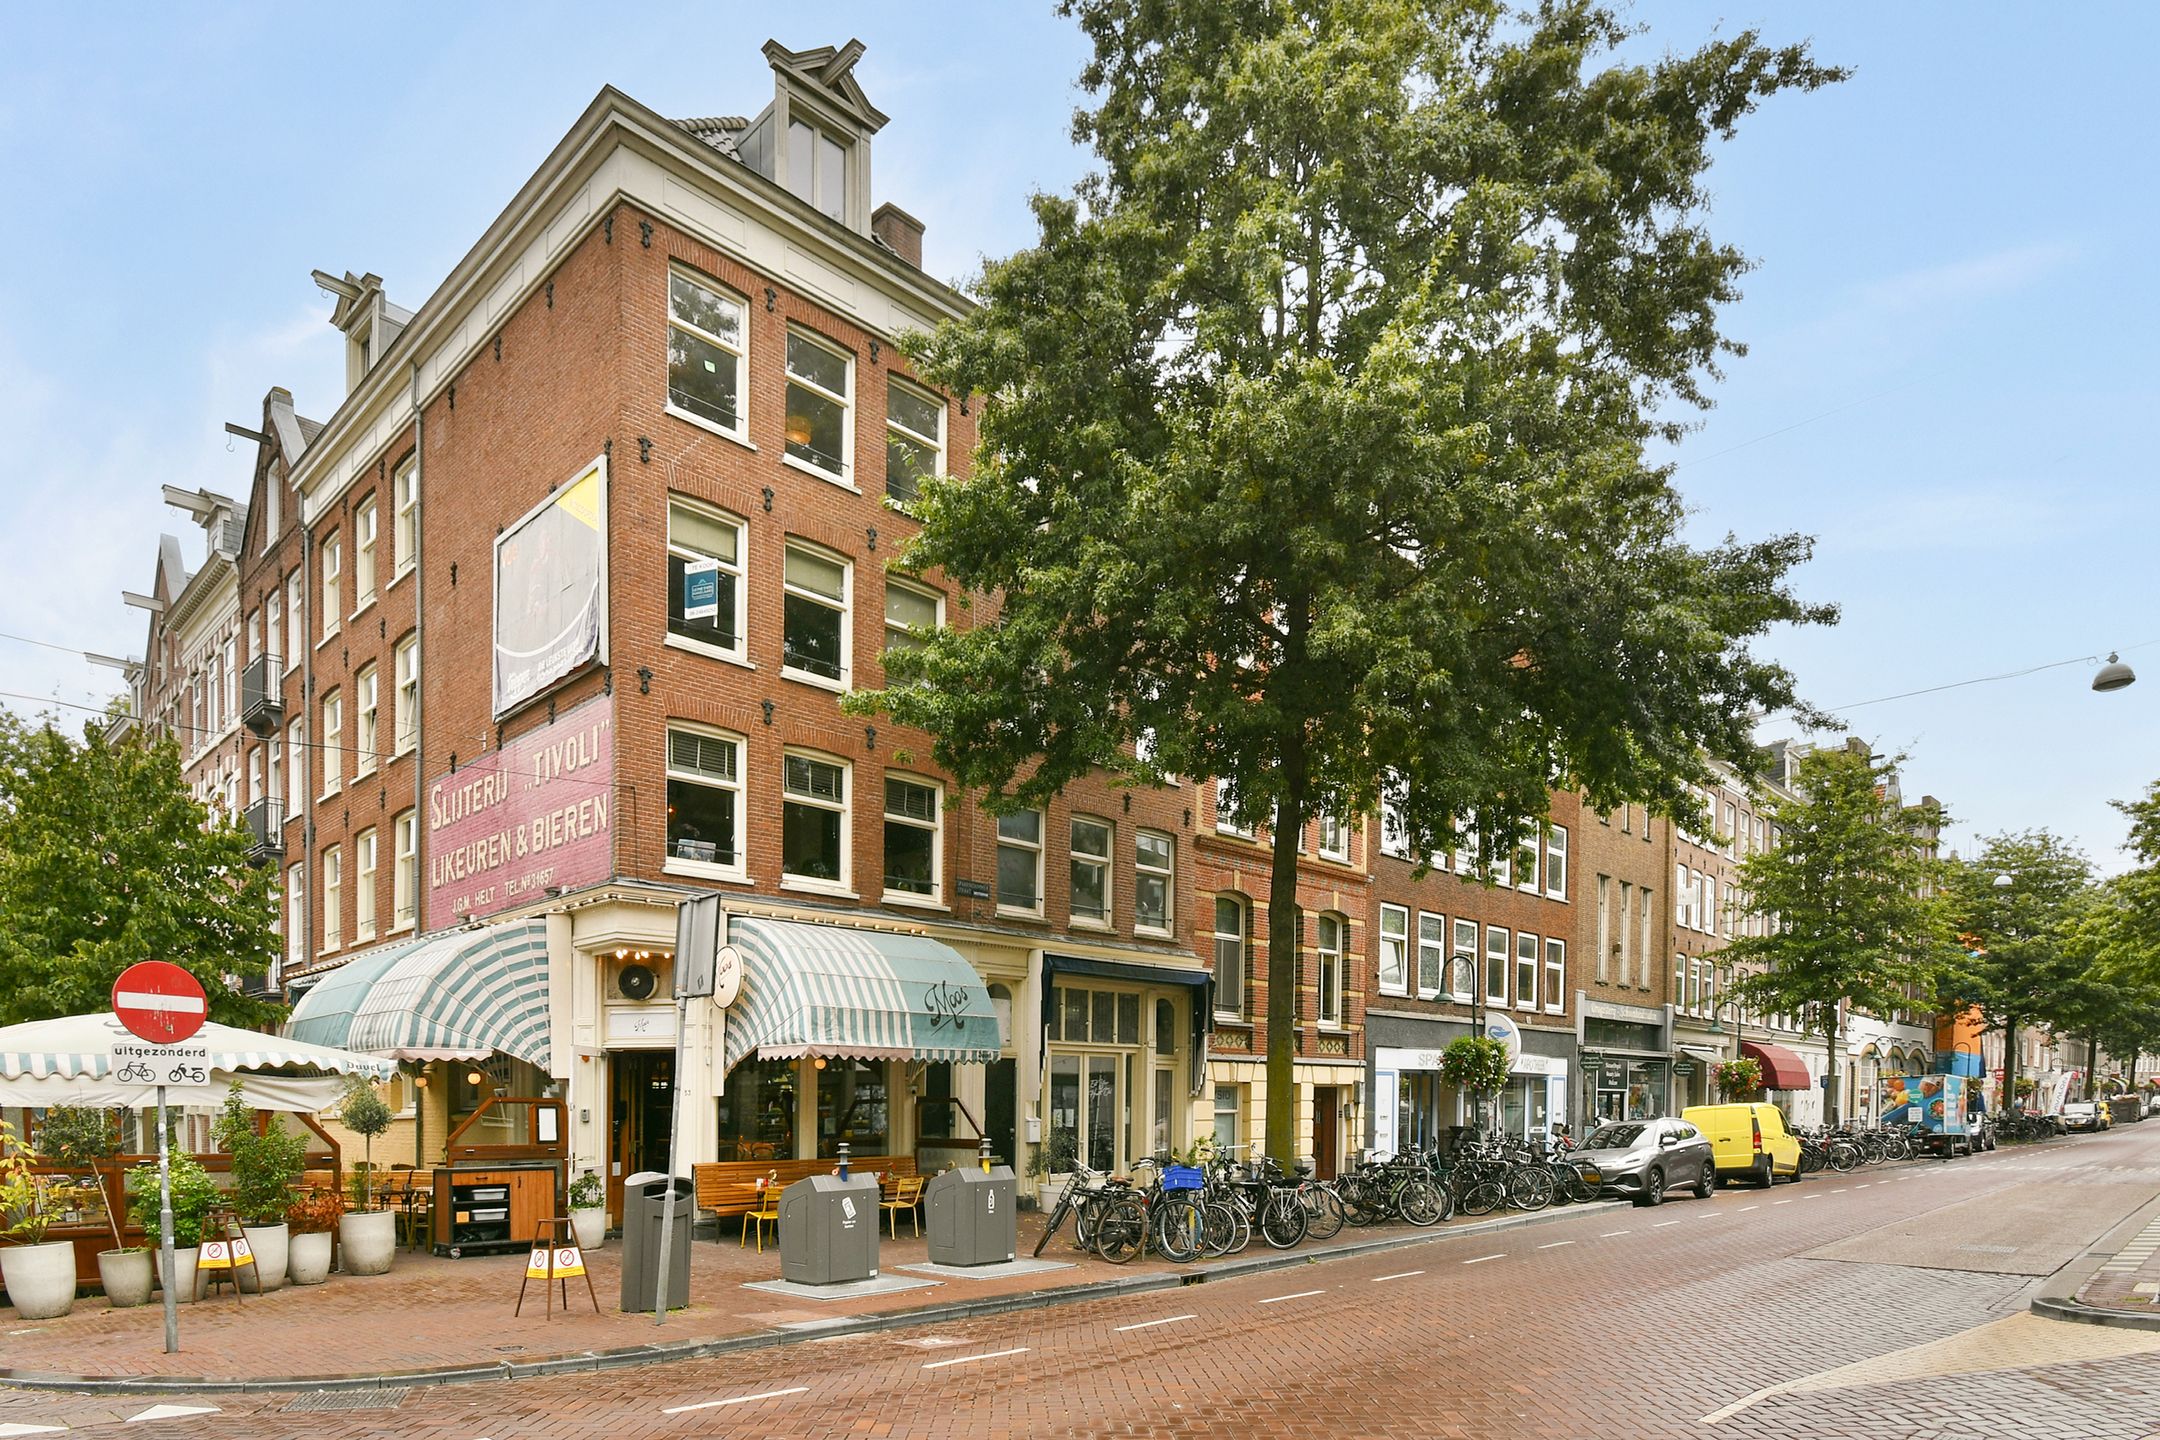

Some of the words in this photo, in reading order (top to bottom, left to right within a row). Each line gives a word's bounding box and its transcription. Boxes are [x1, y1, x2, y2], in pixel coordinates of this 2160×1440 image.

[432, 829, 512, 888] LIKEUREN
[516, 824, 529, 858] &
[532, 793, 608, 853] BIEREN
[475, 886, 496, 907] HELT
[924, 980, 968, 1030] Moos
[115, 1046, 206, 1058] uitgezonderd
